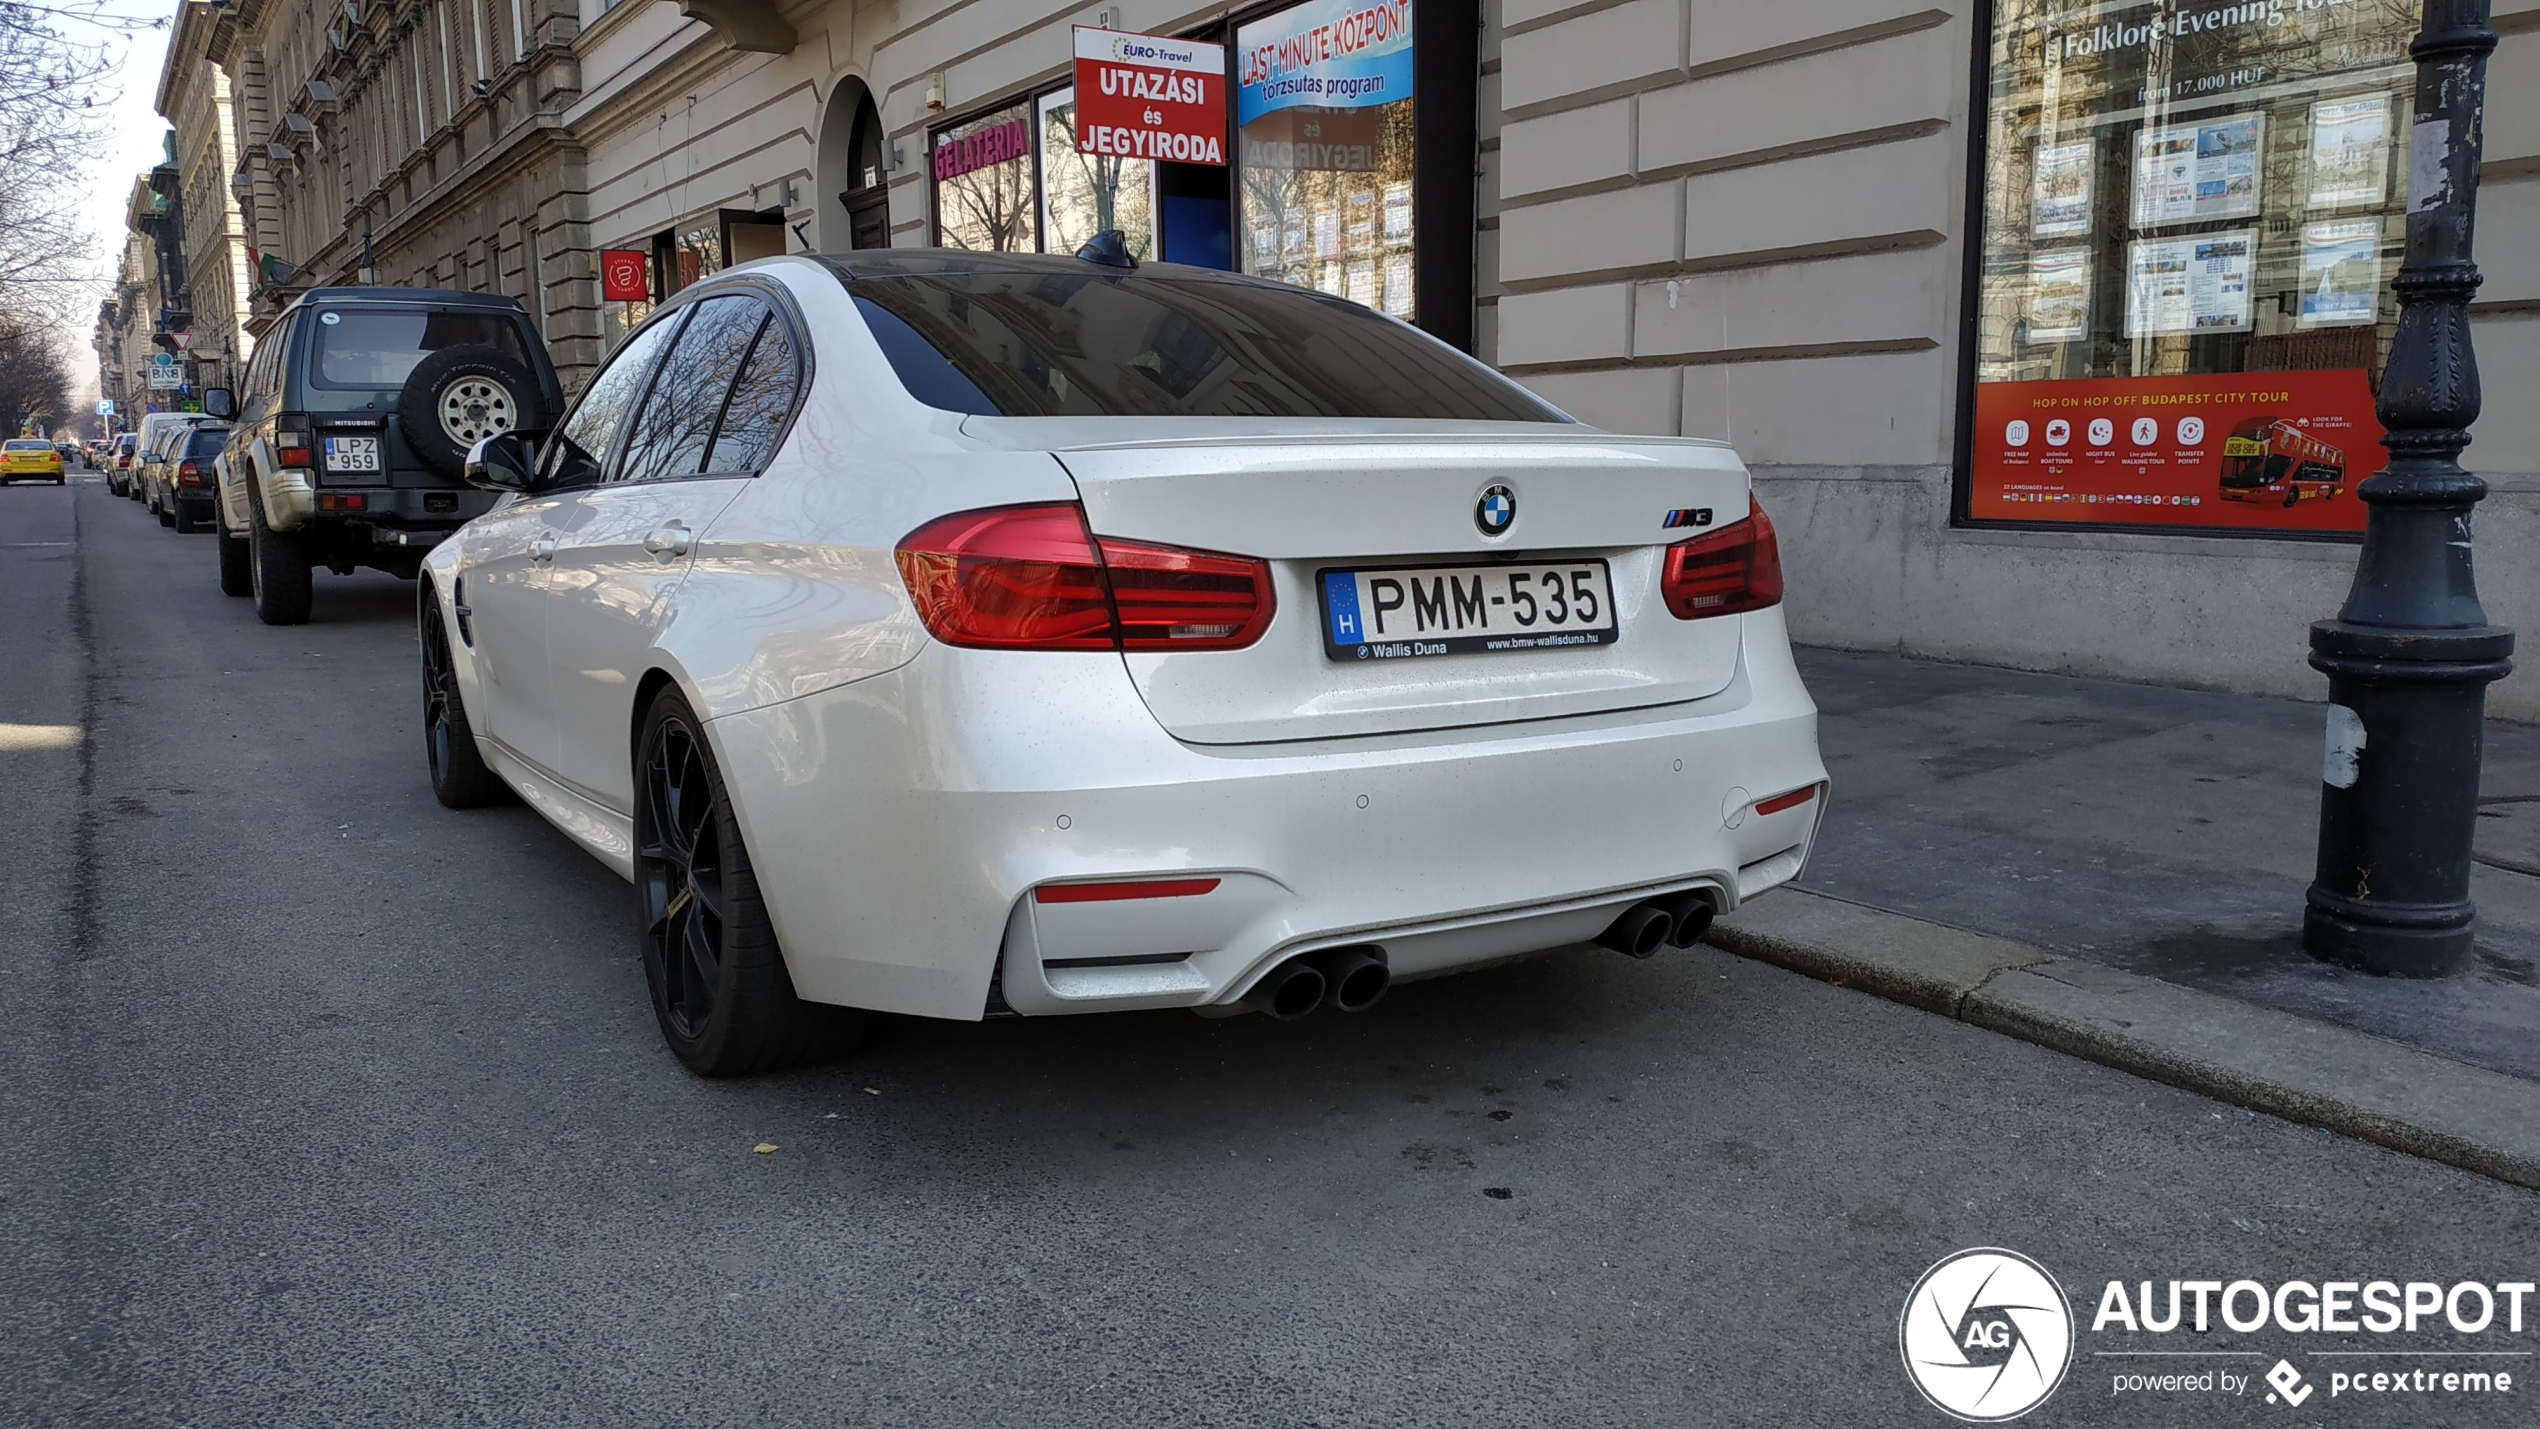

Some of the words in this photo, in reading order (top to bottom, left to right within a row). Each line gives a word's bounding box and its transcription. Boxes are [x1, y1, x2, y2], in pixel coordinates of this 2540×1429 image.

[2065, 20, 2166, 59] Folklore
[2175, 0, 2286, 36] Evening
[1123, 44, 1193, 63] EURO-Travel
[1242, 44, 1275, 87] LAST
[1278, 25, 1330, 75] MINUTE
[1333, 0, 1408, 57] KÖZPONT
[1100, 68, 1204, 105] UTAZÁSI
[1262, 74, 1323, 101] törzsutas
[1326, 74, 1385, 99] program
[2138, 86, 2170, 101] from
[2175, 73, 2225, 95] 17.000
[2230, 67, 2266, 85] HUF
[1143, 106, 1162, 125] és
[934, 118, 1028, 181] GELATERIA
[1082, 125, 1222, 163] JEGYIRODA
[2033, 398, 2057, 408] HOP
[2061, 397, 2079, 407] ON
[2083, 397, 2109, 407] HOP
[2113, 396, 2137, 406] OFF
[2142, 393, 2210, 405] BUDAPEST
[2215, 392, 2246, 404] CITY
[2250, 392, 2289, 403] TOUR
[336, 439, 376, 454] LPZ
[341, 455, 374, 469] 959
[1369, 570, 1599, 634] PMM-535
[1338, 614, 1354, 634] H
[1372, 643, 1411, 658] Wallis
[1415, 642, 1447, 656] Duna
[1487, 634, 1599, 650] www.bmw-wallisduna.hu
